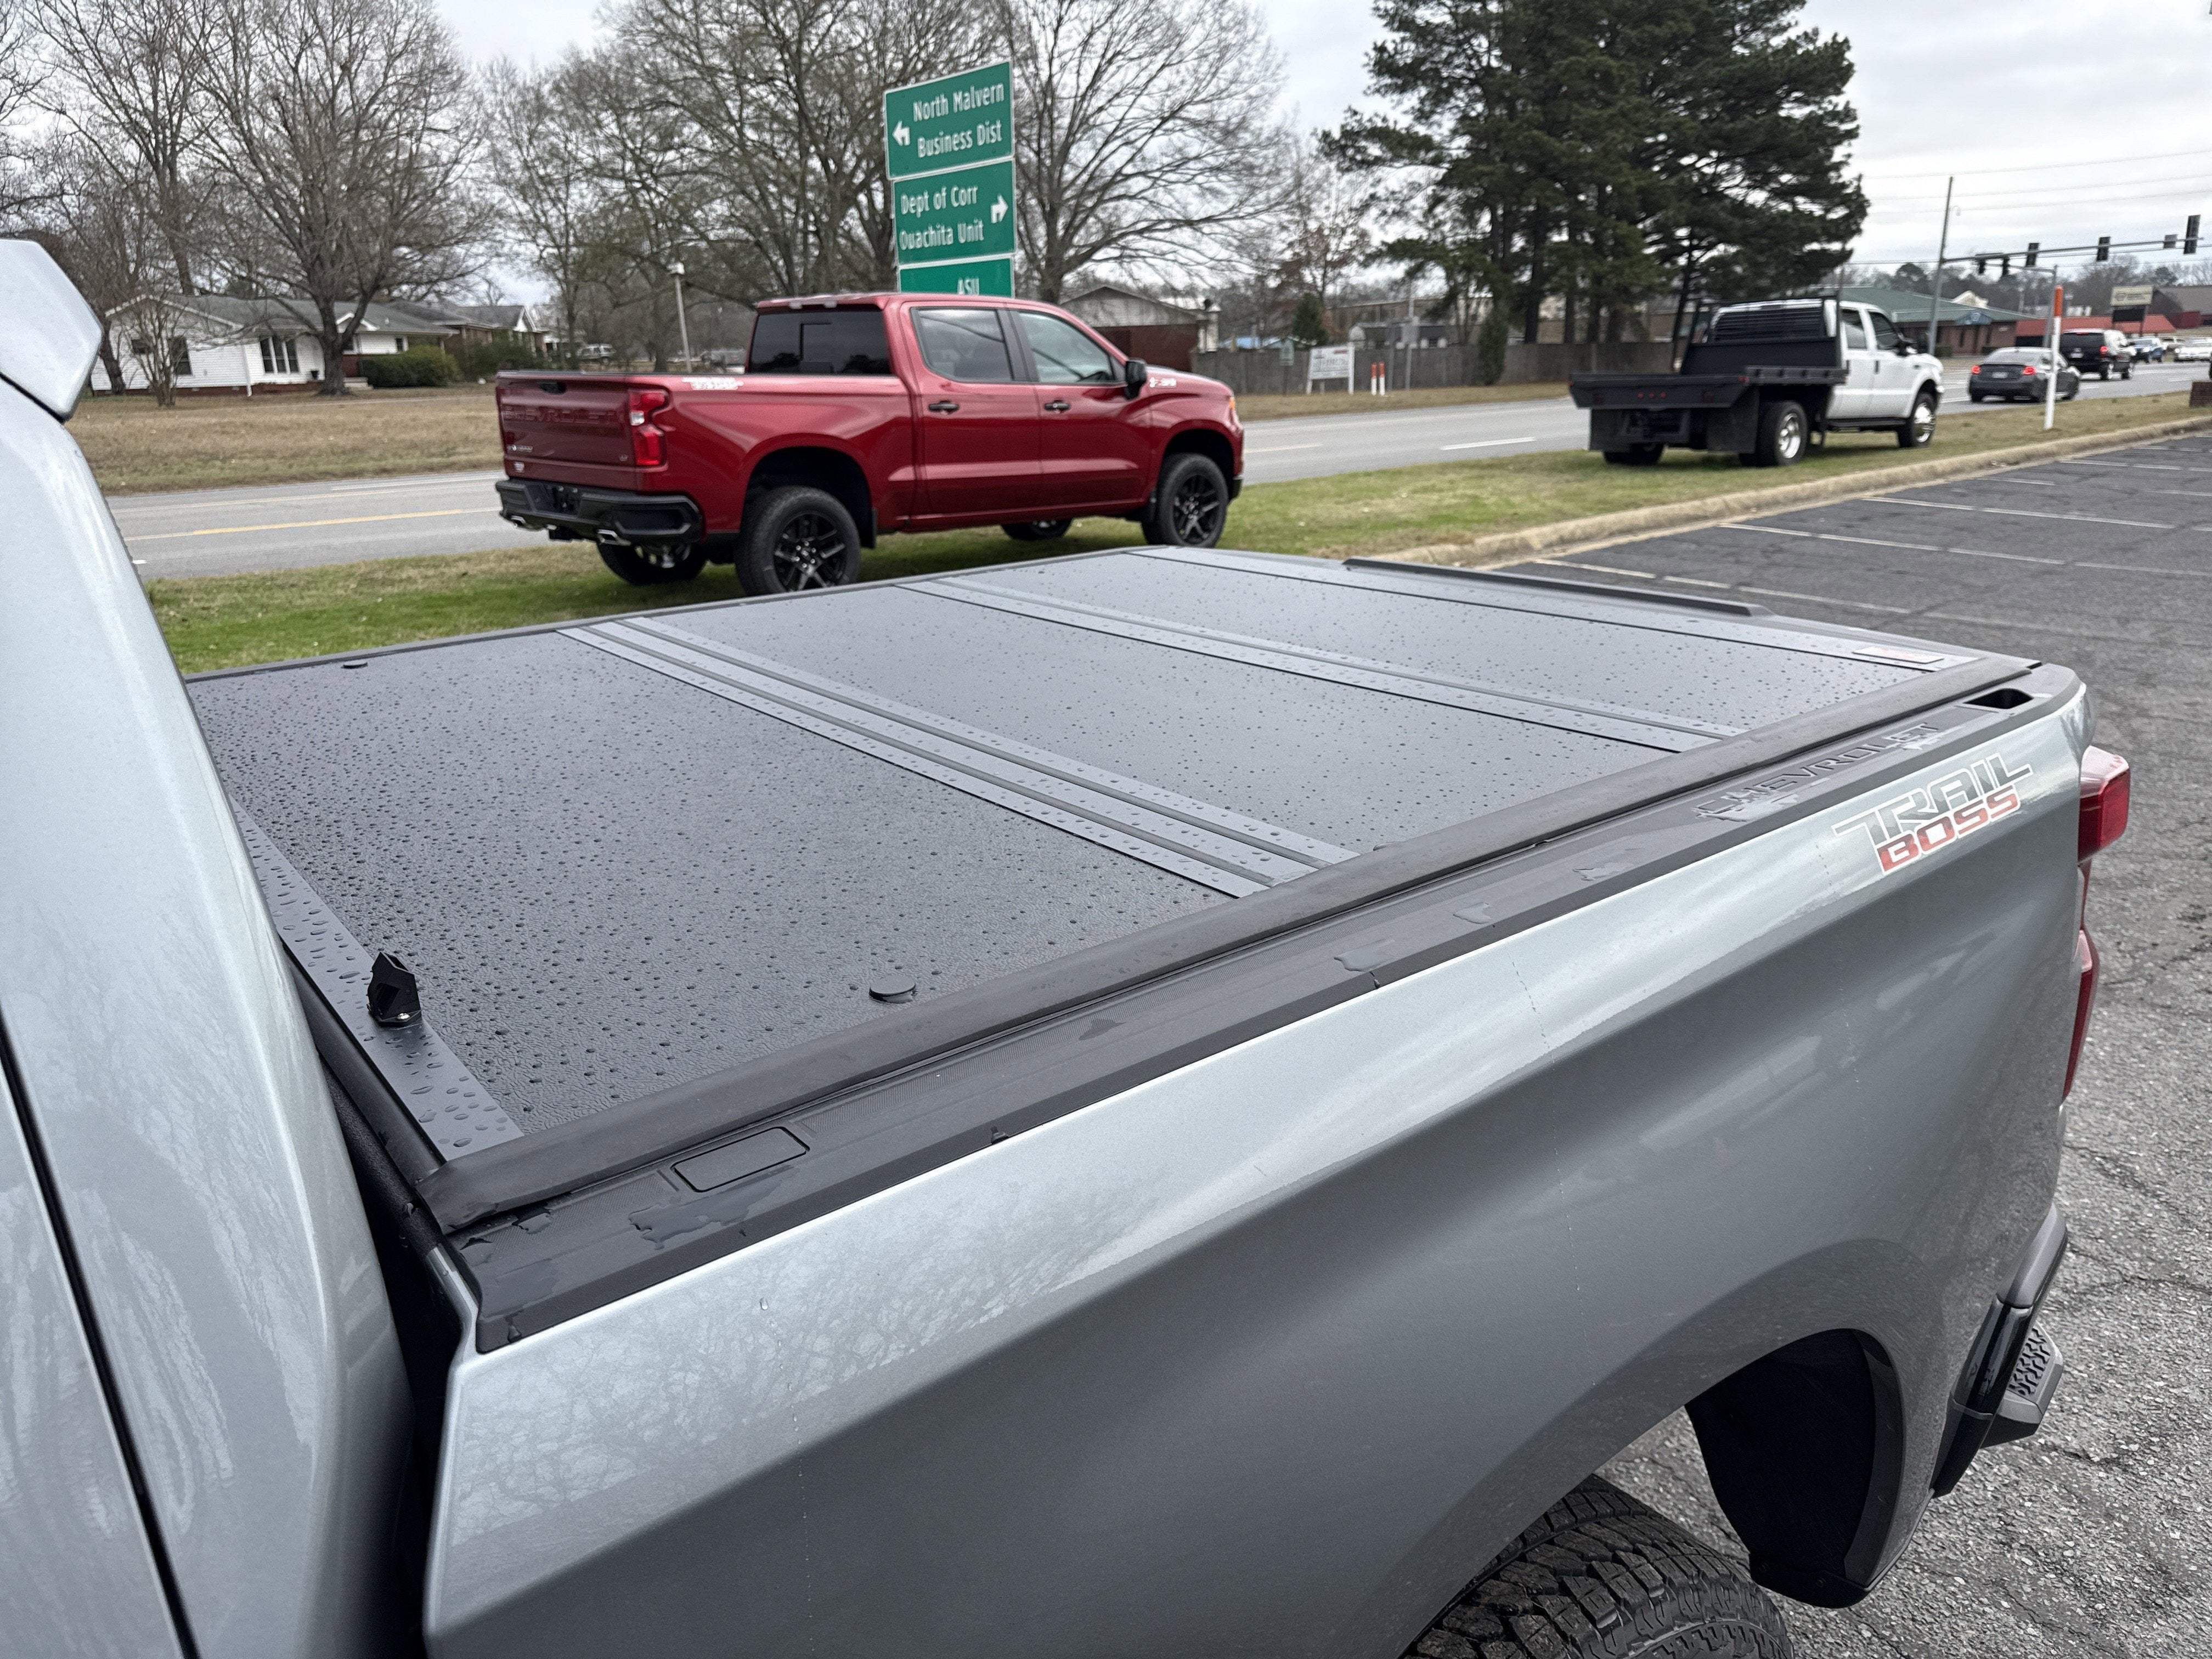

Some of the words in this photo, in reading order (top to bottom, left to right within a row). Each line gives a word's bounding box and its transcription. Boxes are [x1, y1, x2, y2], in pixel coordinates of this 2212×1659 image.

[913, 93, 949, 122] North
[953, 83, 1005, 113] Malvern
[917, 130, 973, 158] Business
[977, 120, 1002, 146] Dist
[900, 190, 929, 218] Dept
[933, 187, 947, 211] of
[950, 185, 978, 208] Corr
[899, 224, 953, 251] Ouachita
[957, 219, 984, 244] Unit
[957, 278, 979, 295] ASU
[1694, 722, 1939, 815] CHEVROLET
[1831, 752, 2033, 846] TRAIL
[1876, 783, 2021, 876] BOSS
